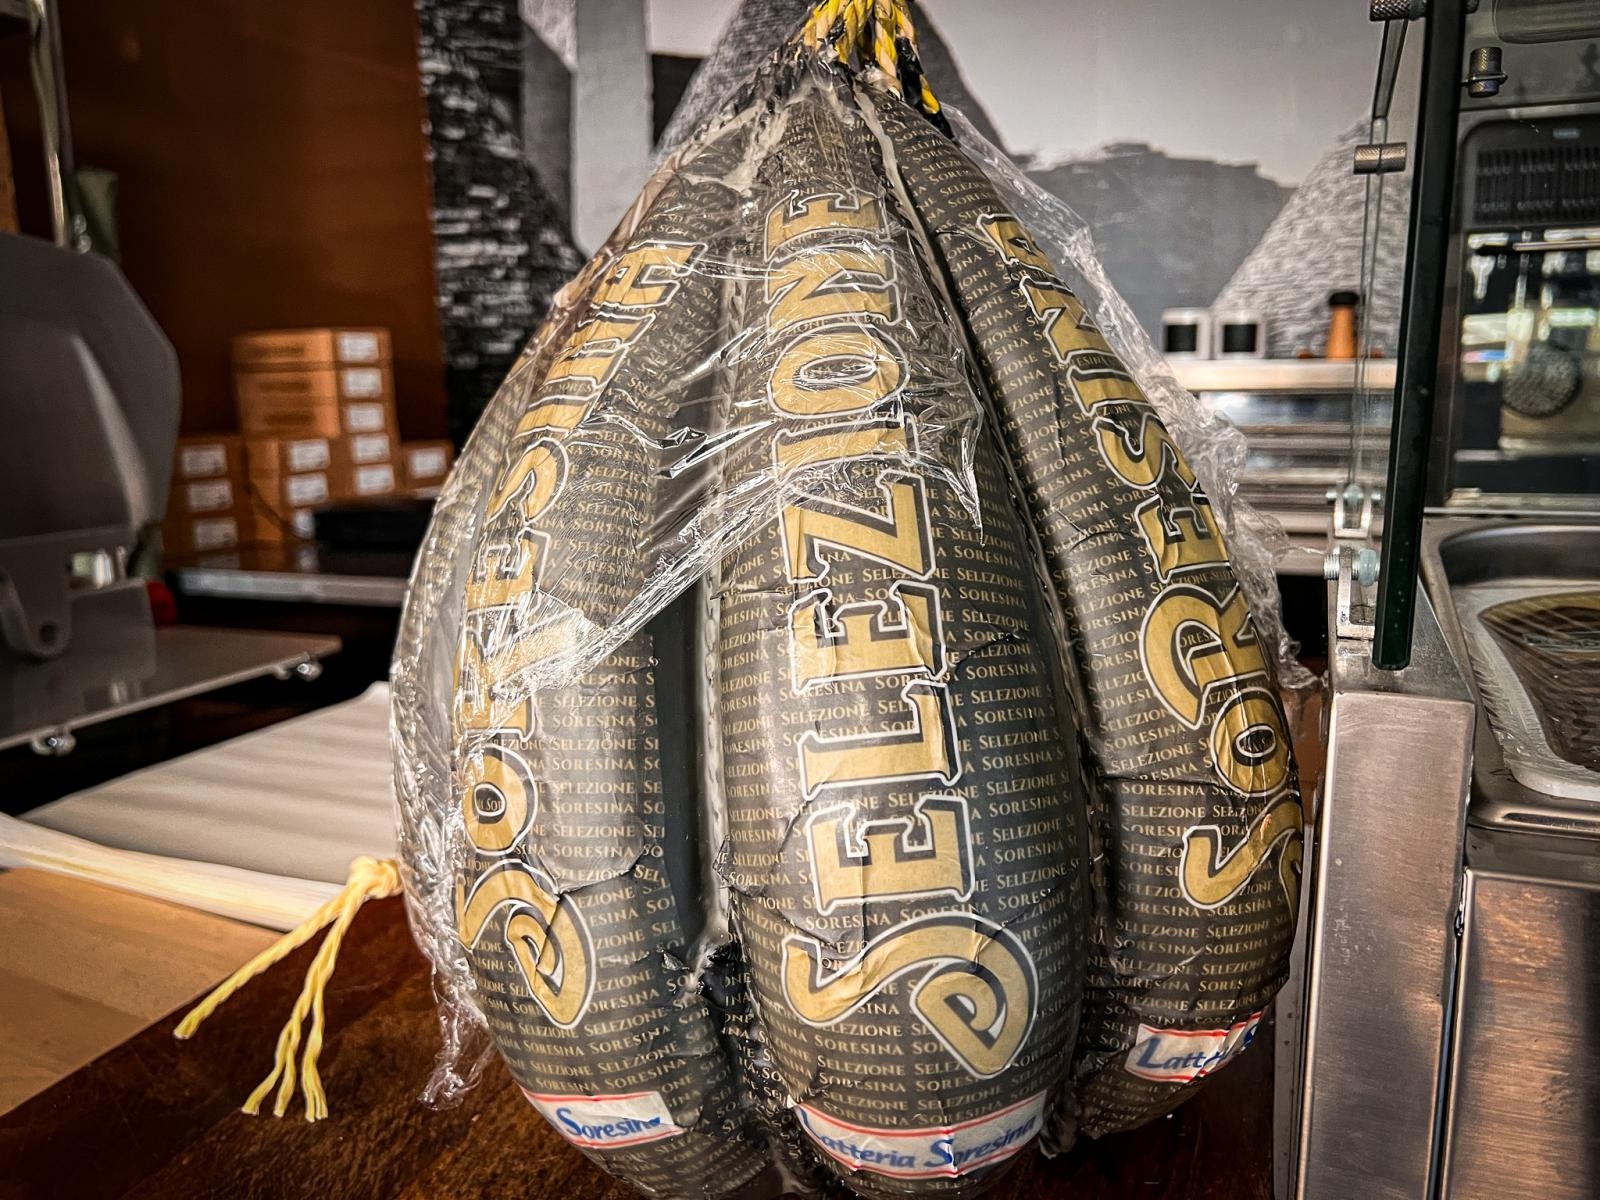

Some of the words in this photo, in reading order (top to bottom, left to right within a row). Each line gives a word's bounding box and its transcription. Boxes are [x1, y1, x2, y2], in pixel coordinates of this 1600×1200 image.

[959, 587, 1027, 610] SORESINA
[1064, 586, 1145, 620] SELEZIONE
[578, 671, 638, 686] RESINA
[966, 664, 1037, 681] SORESINA
[970, 685, 1042, 705] SELEZIONE
[551, 714, 637, 728] SORESINA
[974, 707, 1046, 727] SORESINA
[552, 736, 638, 752] SELEZIONE
[979, 728, 1050, 751] SELEZIONE
[1103, 723, 1187, 752] SORESINA
[551, 758, 636, 771] SORESINA
[982, 751, 1053, 772] SORESINA
[1110, 742, 1193, 773] SELEZIONE
[551, 781, 636, 795] SELEZIONE
[986, 774, 1056, 797] SELEZIONE
[1120, 783, 1206, 797] SORESINA
[551, 800, 635, 815] SORESINA
[989, 797, 1060, 819] SORESINA
[1120, 803, 1206, 819] SELEZIONE
[552, 824, 635, 838] SELEZIONE
[992, 818, 1062, 844] SELEZIONE
[552, 844, 636, 859] SORESINA
[994, 840, 1064, 865] SORESINA
[1120, 842, 1183, 859] SELEZIO
[996, 862, 1068, 890] SELEZIONE
[1119, 859, 1180, 877] SORESI
[577, 886, 636, 909] EZIONE
[1118, 879, 1183, 899] SELEZIO
[590, 907, 640, 928] ESINA
[1117, 898, 1201, 918] SORESINA
[595, 928, 646, 950] ZIONE
[1115, 918, 1200, 939] SELEZIONE
[1204, 936, 1269, 957] SORESINA
[584, 1009, 667, 1037] SELEZIONE
[589, 1024, 671, 1055] SORESINA
[814, 1034, 905, 1056] SORESINA
[604, 1058, 687, 1089] SORESINA
[816, 1054, 905, 1077] SELEZIONE
[822, 1088, 909, 1112] SELEZIONE
[924, 1115, 1038, 1168] Soresina
